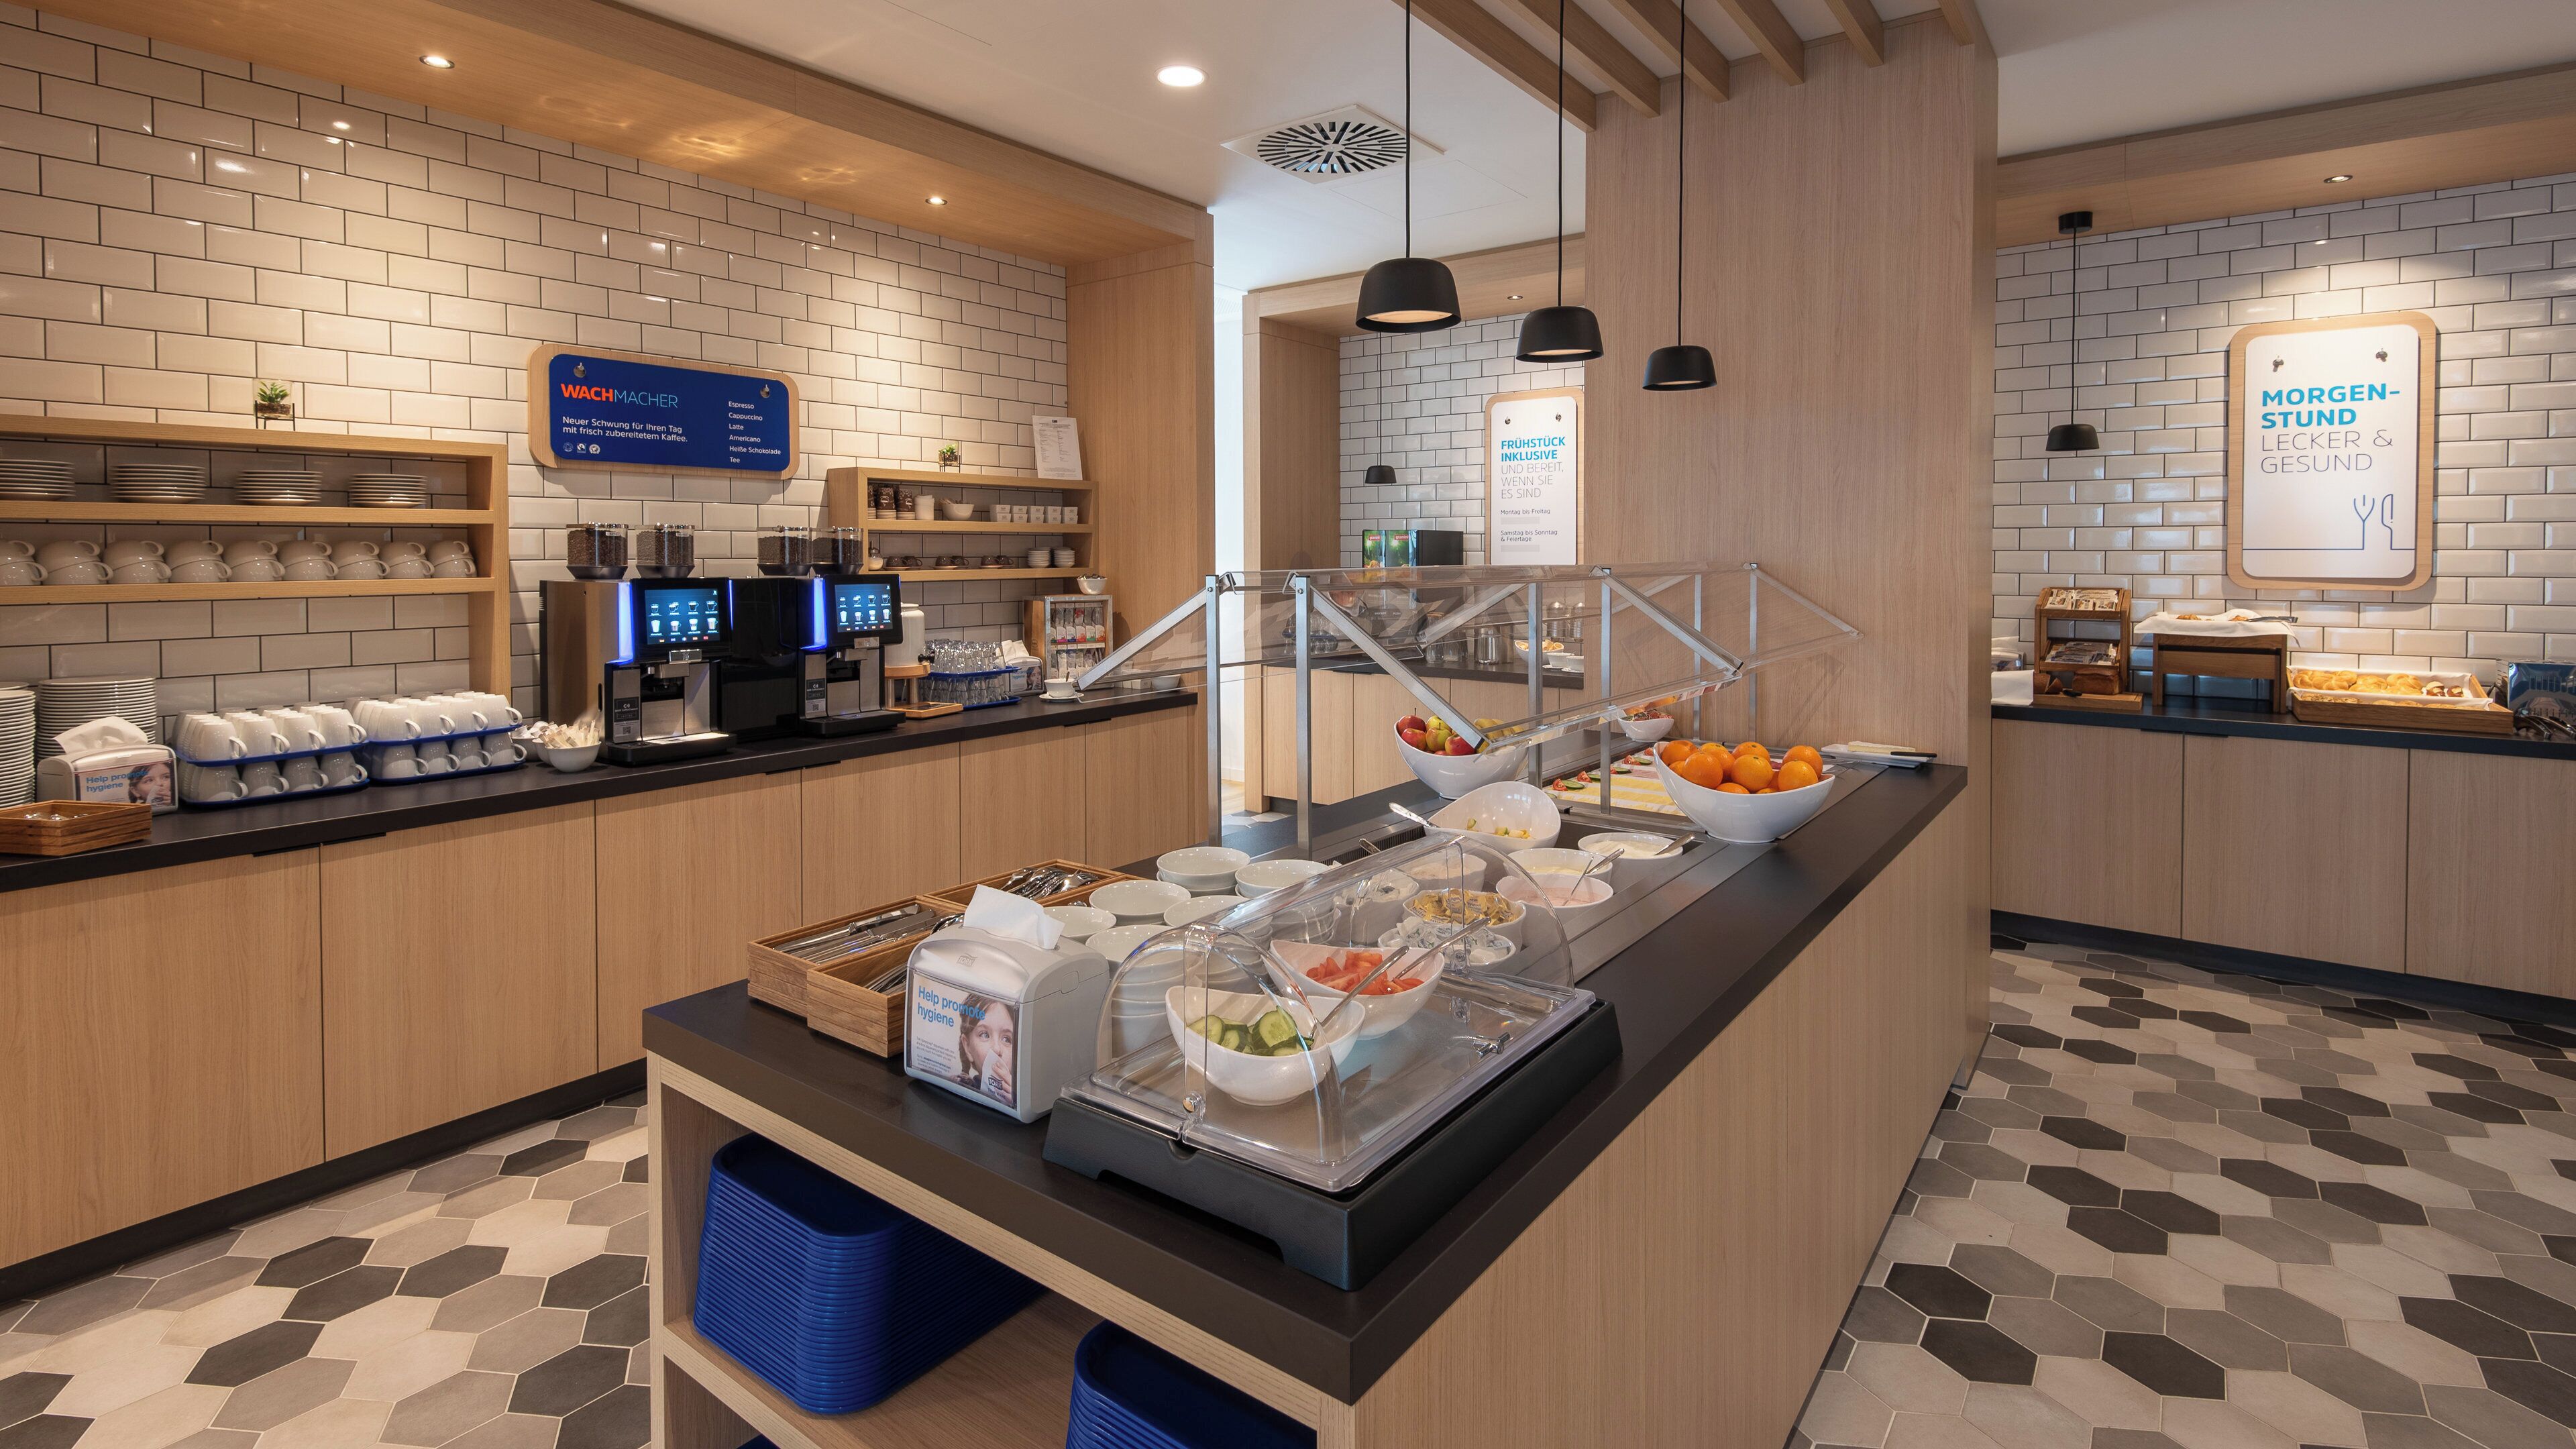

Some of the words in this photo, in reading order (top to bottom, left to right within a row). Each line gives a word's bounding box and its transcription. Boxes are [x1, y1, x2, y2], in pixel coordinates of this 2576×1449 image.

[2262, 383, 2400, 407] MORGEN-
[729, 401, 754, 409] Espresso
[729, 413, 763, 421] Cappuccino
[2261, 409, 2357, 429] STUND
[563, 417, 588, 425] Neuer
[592, 419, 629, 429] Schwung
[669, 425, 682, 433] Tag
[580, 427, 602, 435] frisch
[605, 430, 659, 439] zubereitetem
[1501, 435, 1565, 449] FRÜHSTÜCK
[2262, 431, 2361, 451] LECKER
[2373, 429, 2393, 447] &
[1501, 449, 1558, 462] INKLUSIVE
[1501, 464, 1523, 474] UND
[1527, 462, 1564, 474] BEREIT,
[2261, 453, 2372, 474] GESUND
[1501, 476, 1534, 486] WENN
[1538, 475, 1553, 485] SIE
[1501, 489, 1513, 499] ES
[1517, 488, 1541, 498] SIND
[86, 775, 108, 784] Help
[87, 782, 123, 792] hygiene
[918, 986, 939, 1004] Help
[941, 998, 986, 1021] promote
[917, 1002, 955, 1027] hygiene
